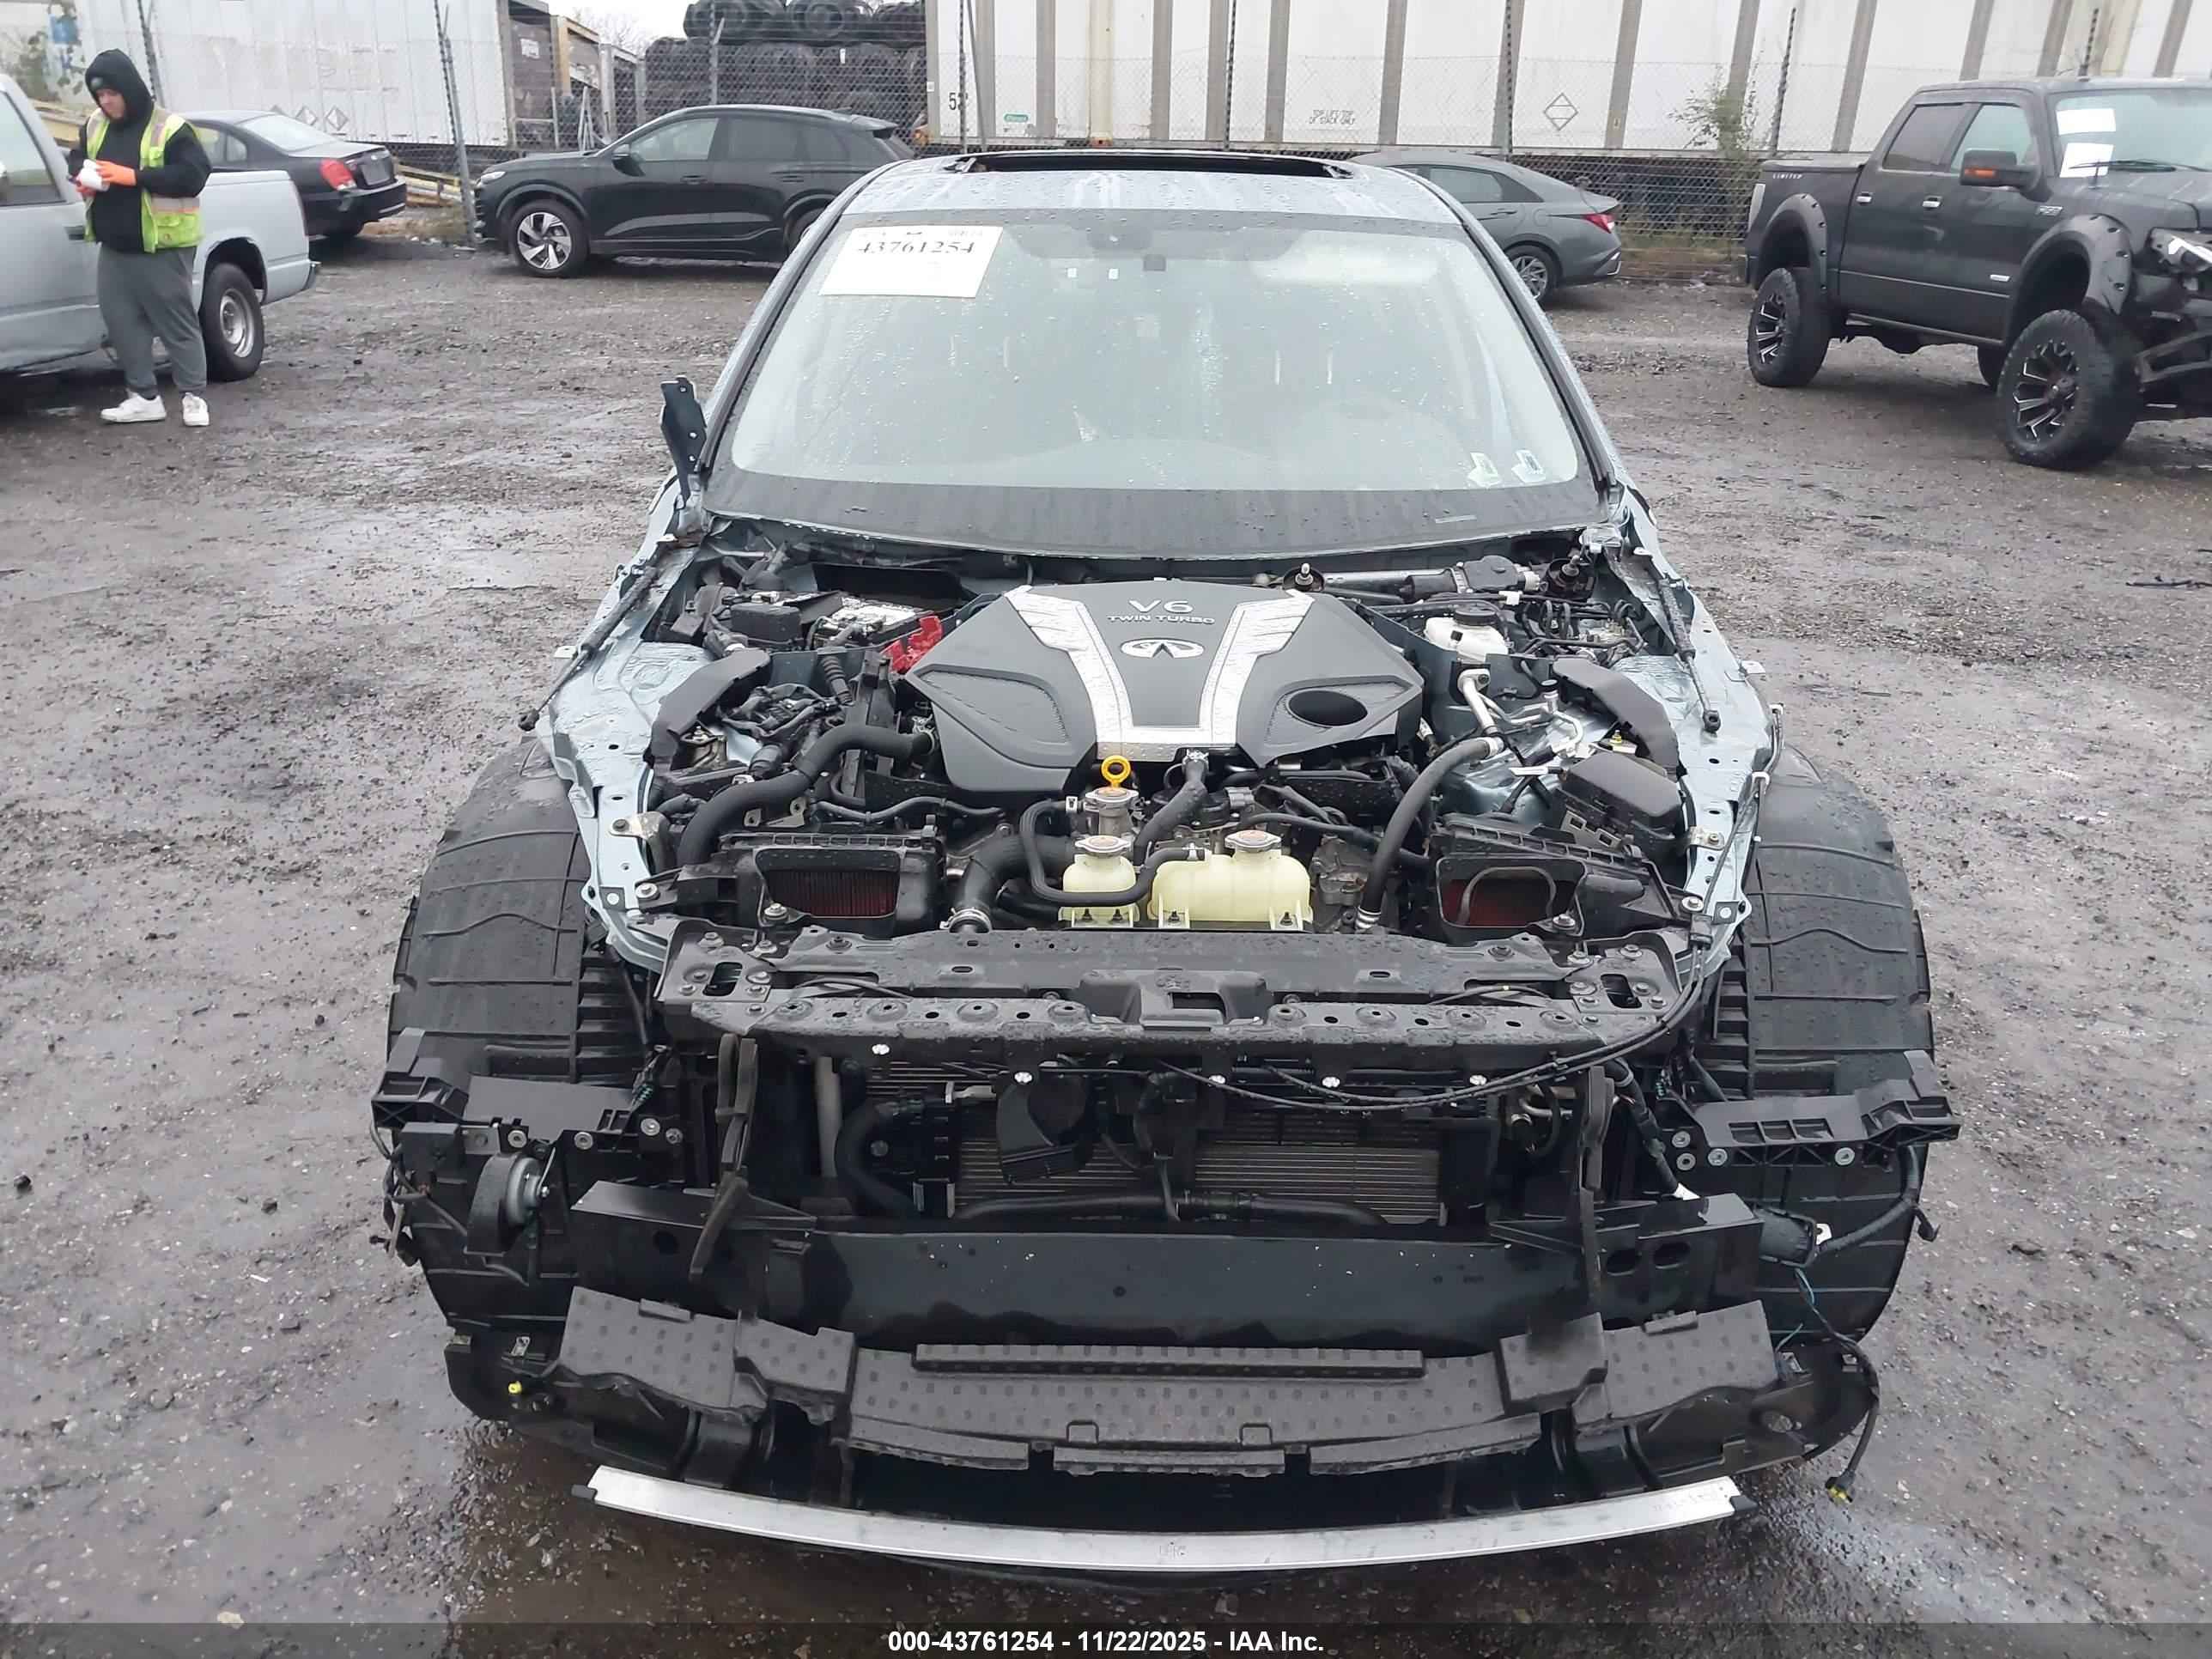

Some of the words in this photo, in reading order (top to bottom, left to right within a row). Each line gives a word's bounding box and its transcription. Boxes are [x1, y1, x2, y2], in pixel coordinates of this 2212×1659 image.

[857, 240, 975, 254] 43761254
[1127, 599, 1194, 614] V6
[1155, 615, 1216, 625] TURBO
